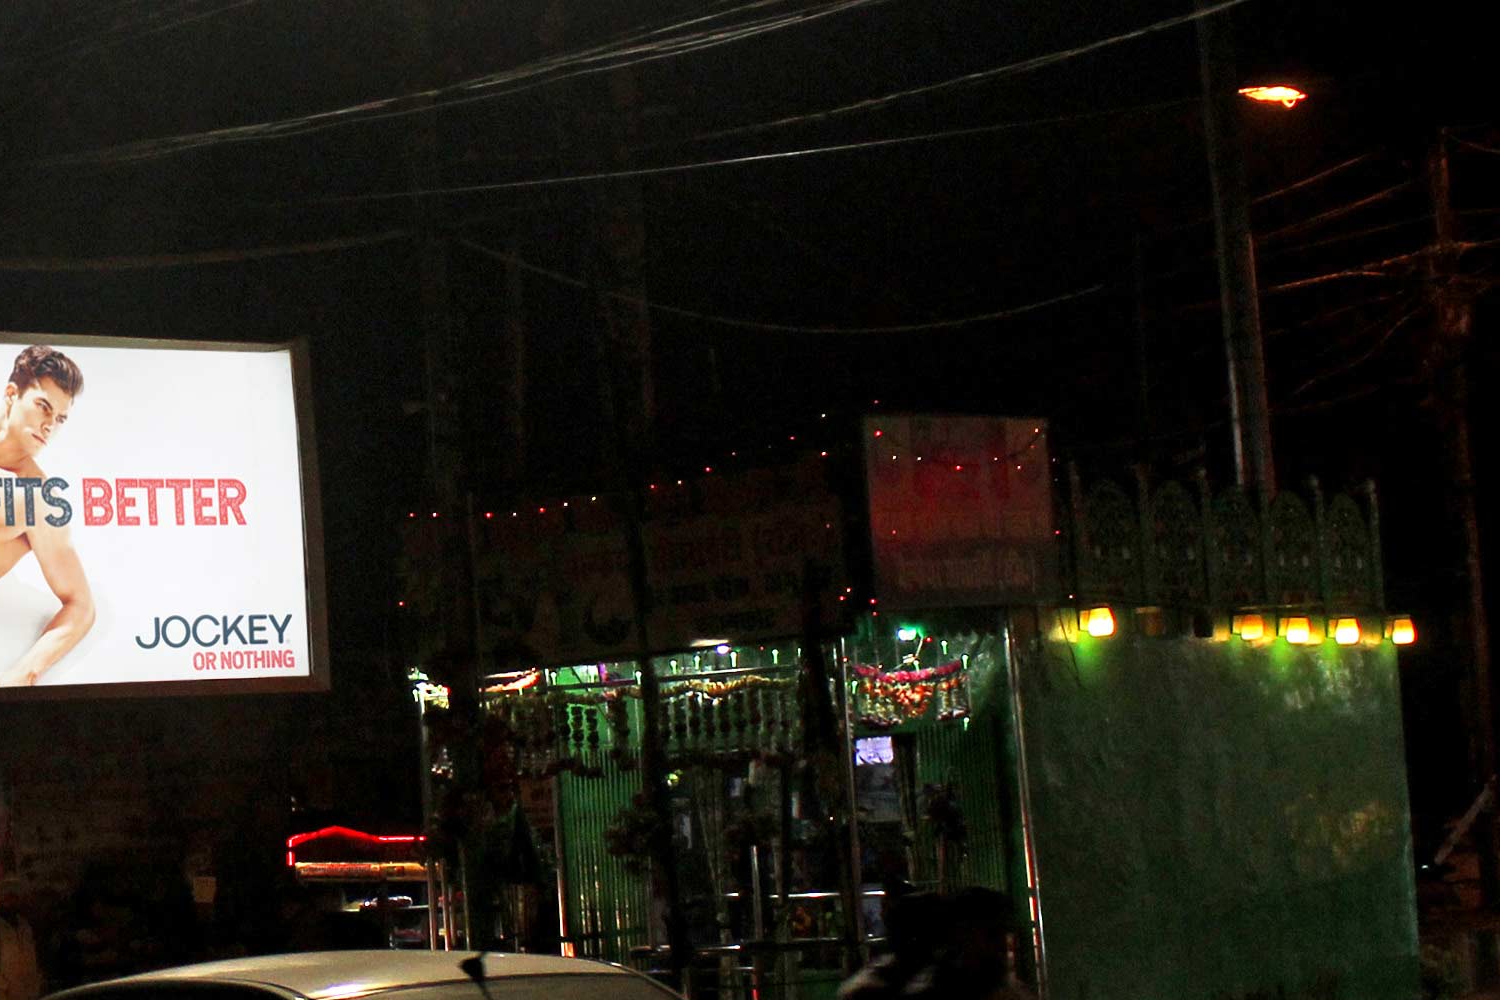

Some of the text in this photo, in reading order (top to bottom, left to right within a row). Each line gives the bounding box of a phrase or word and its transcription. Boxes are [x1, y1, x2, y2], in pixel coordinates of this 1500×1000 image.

[82, 478, 247, 526] BETTER
[135, 614, 293, 649] JOCKEY
[193, 649, 295, 671] OR NOTHING
